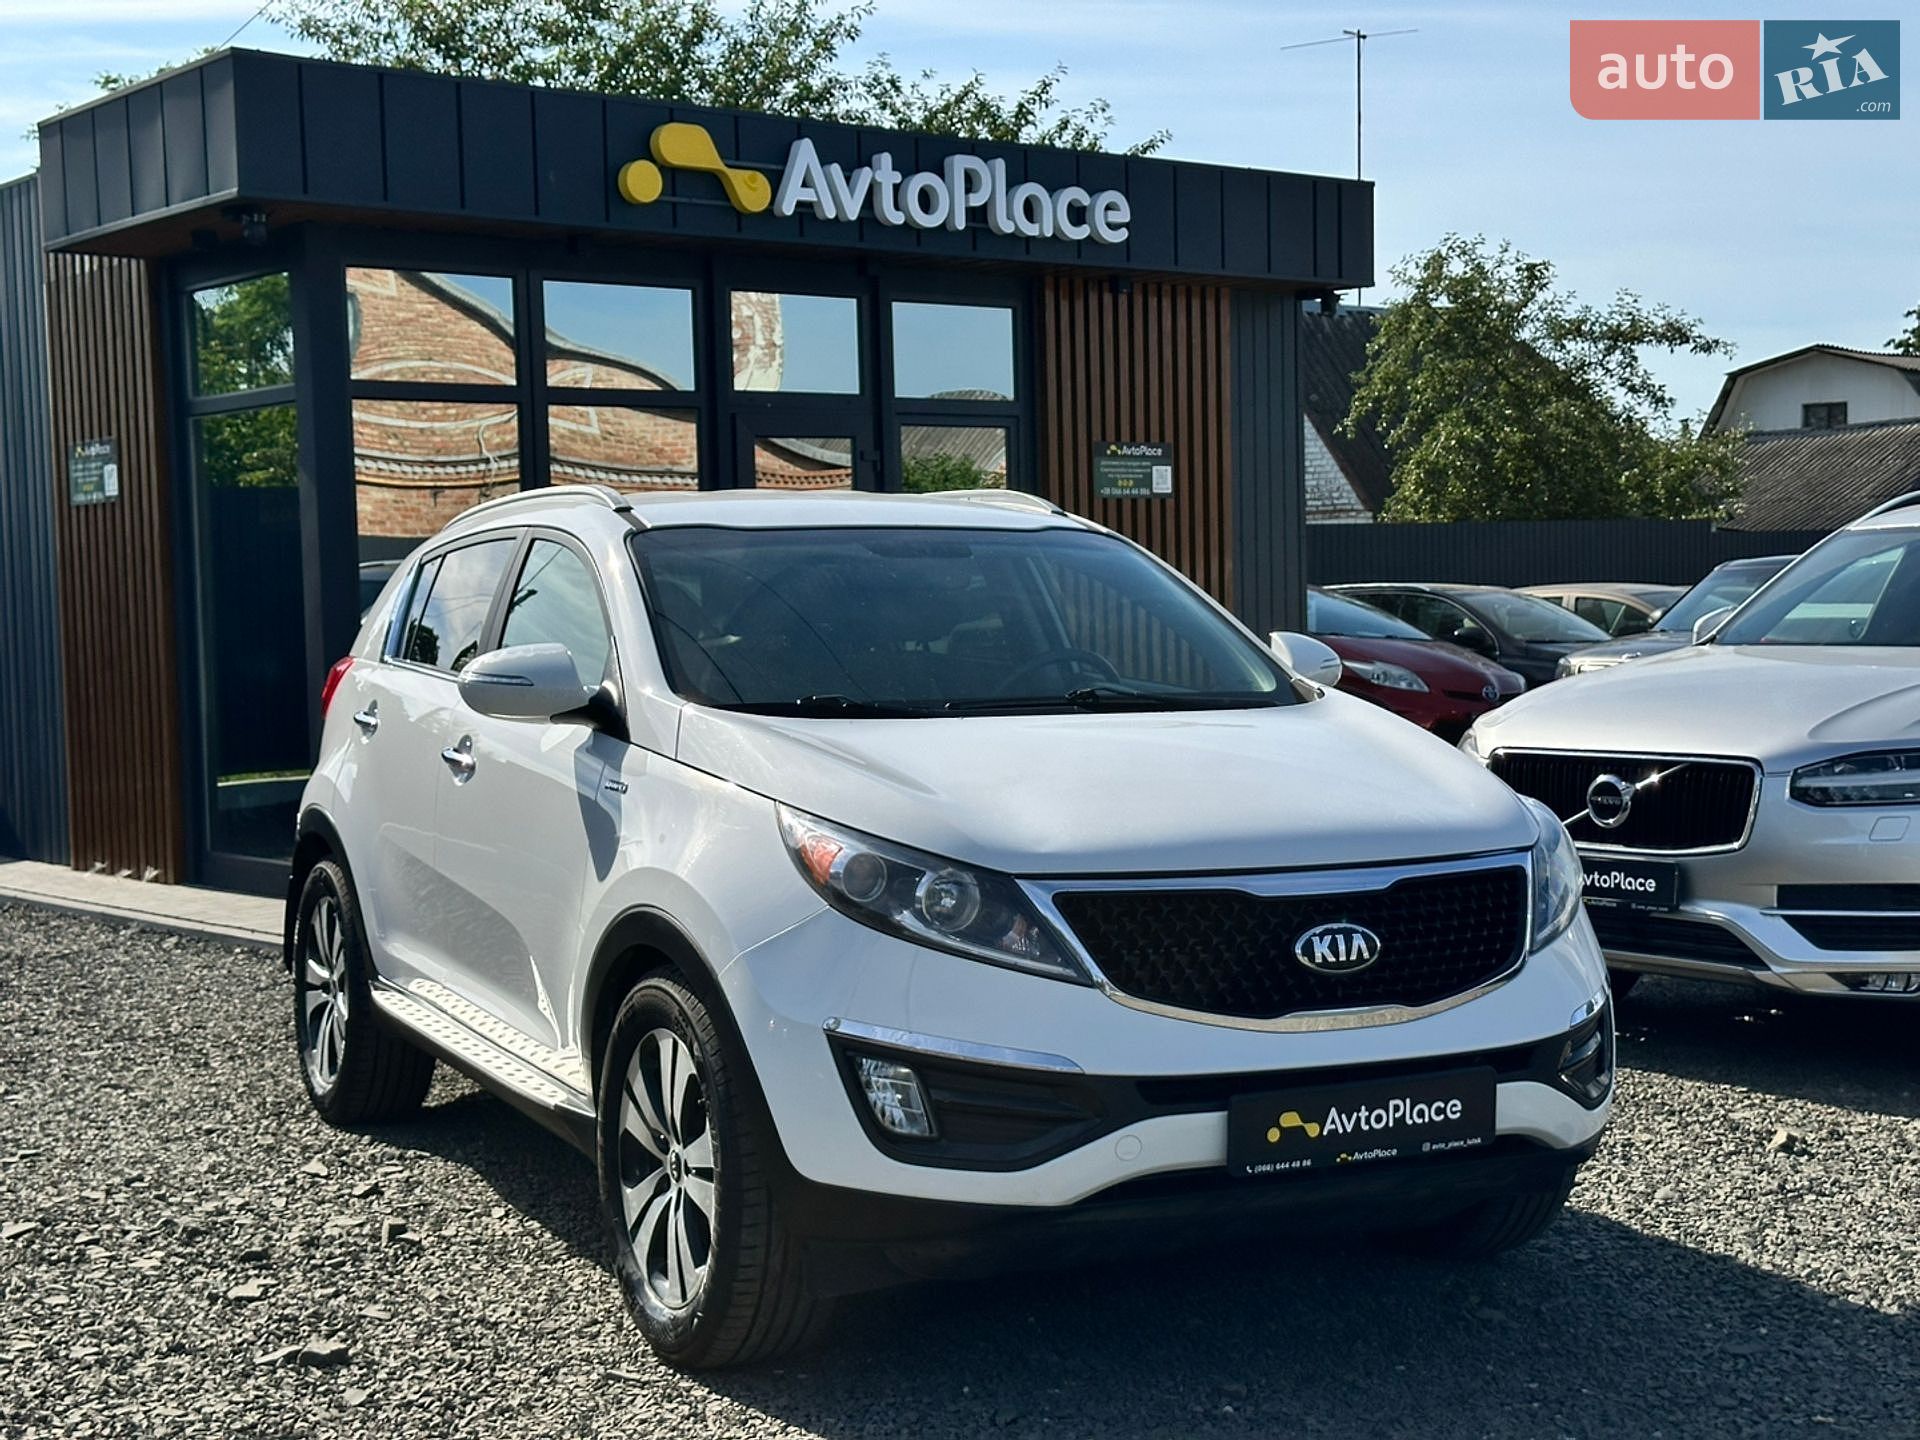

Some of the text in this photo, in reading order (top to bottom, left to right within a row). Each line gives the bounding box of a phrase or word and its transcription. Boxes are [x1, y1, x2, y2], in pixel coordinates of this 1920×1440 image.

[774, 137, 1131, 244] AvtoPlace
[1121, 445, 1162, 456] AvtoPlace
[1582, 871, 1656, 892] vtoPlace
[1311, 933, 1370, 963] KIA
[1322, 1097, 1462, 1136] AvtoPlace
[1353, 1148, 1397, 1160] AvtoPlace
